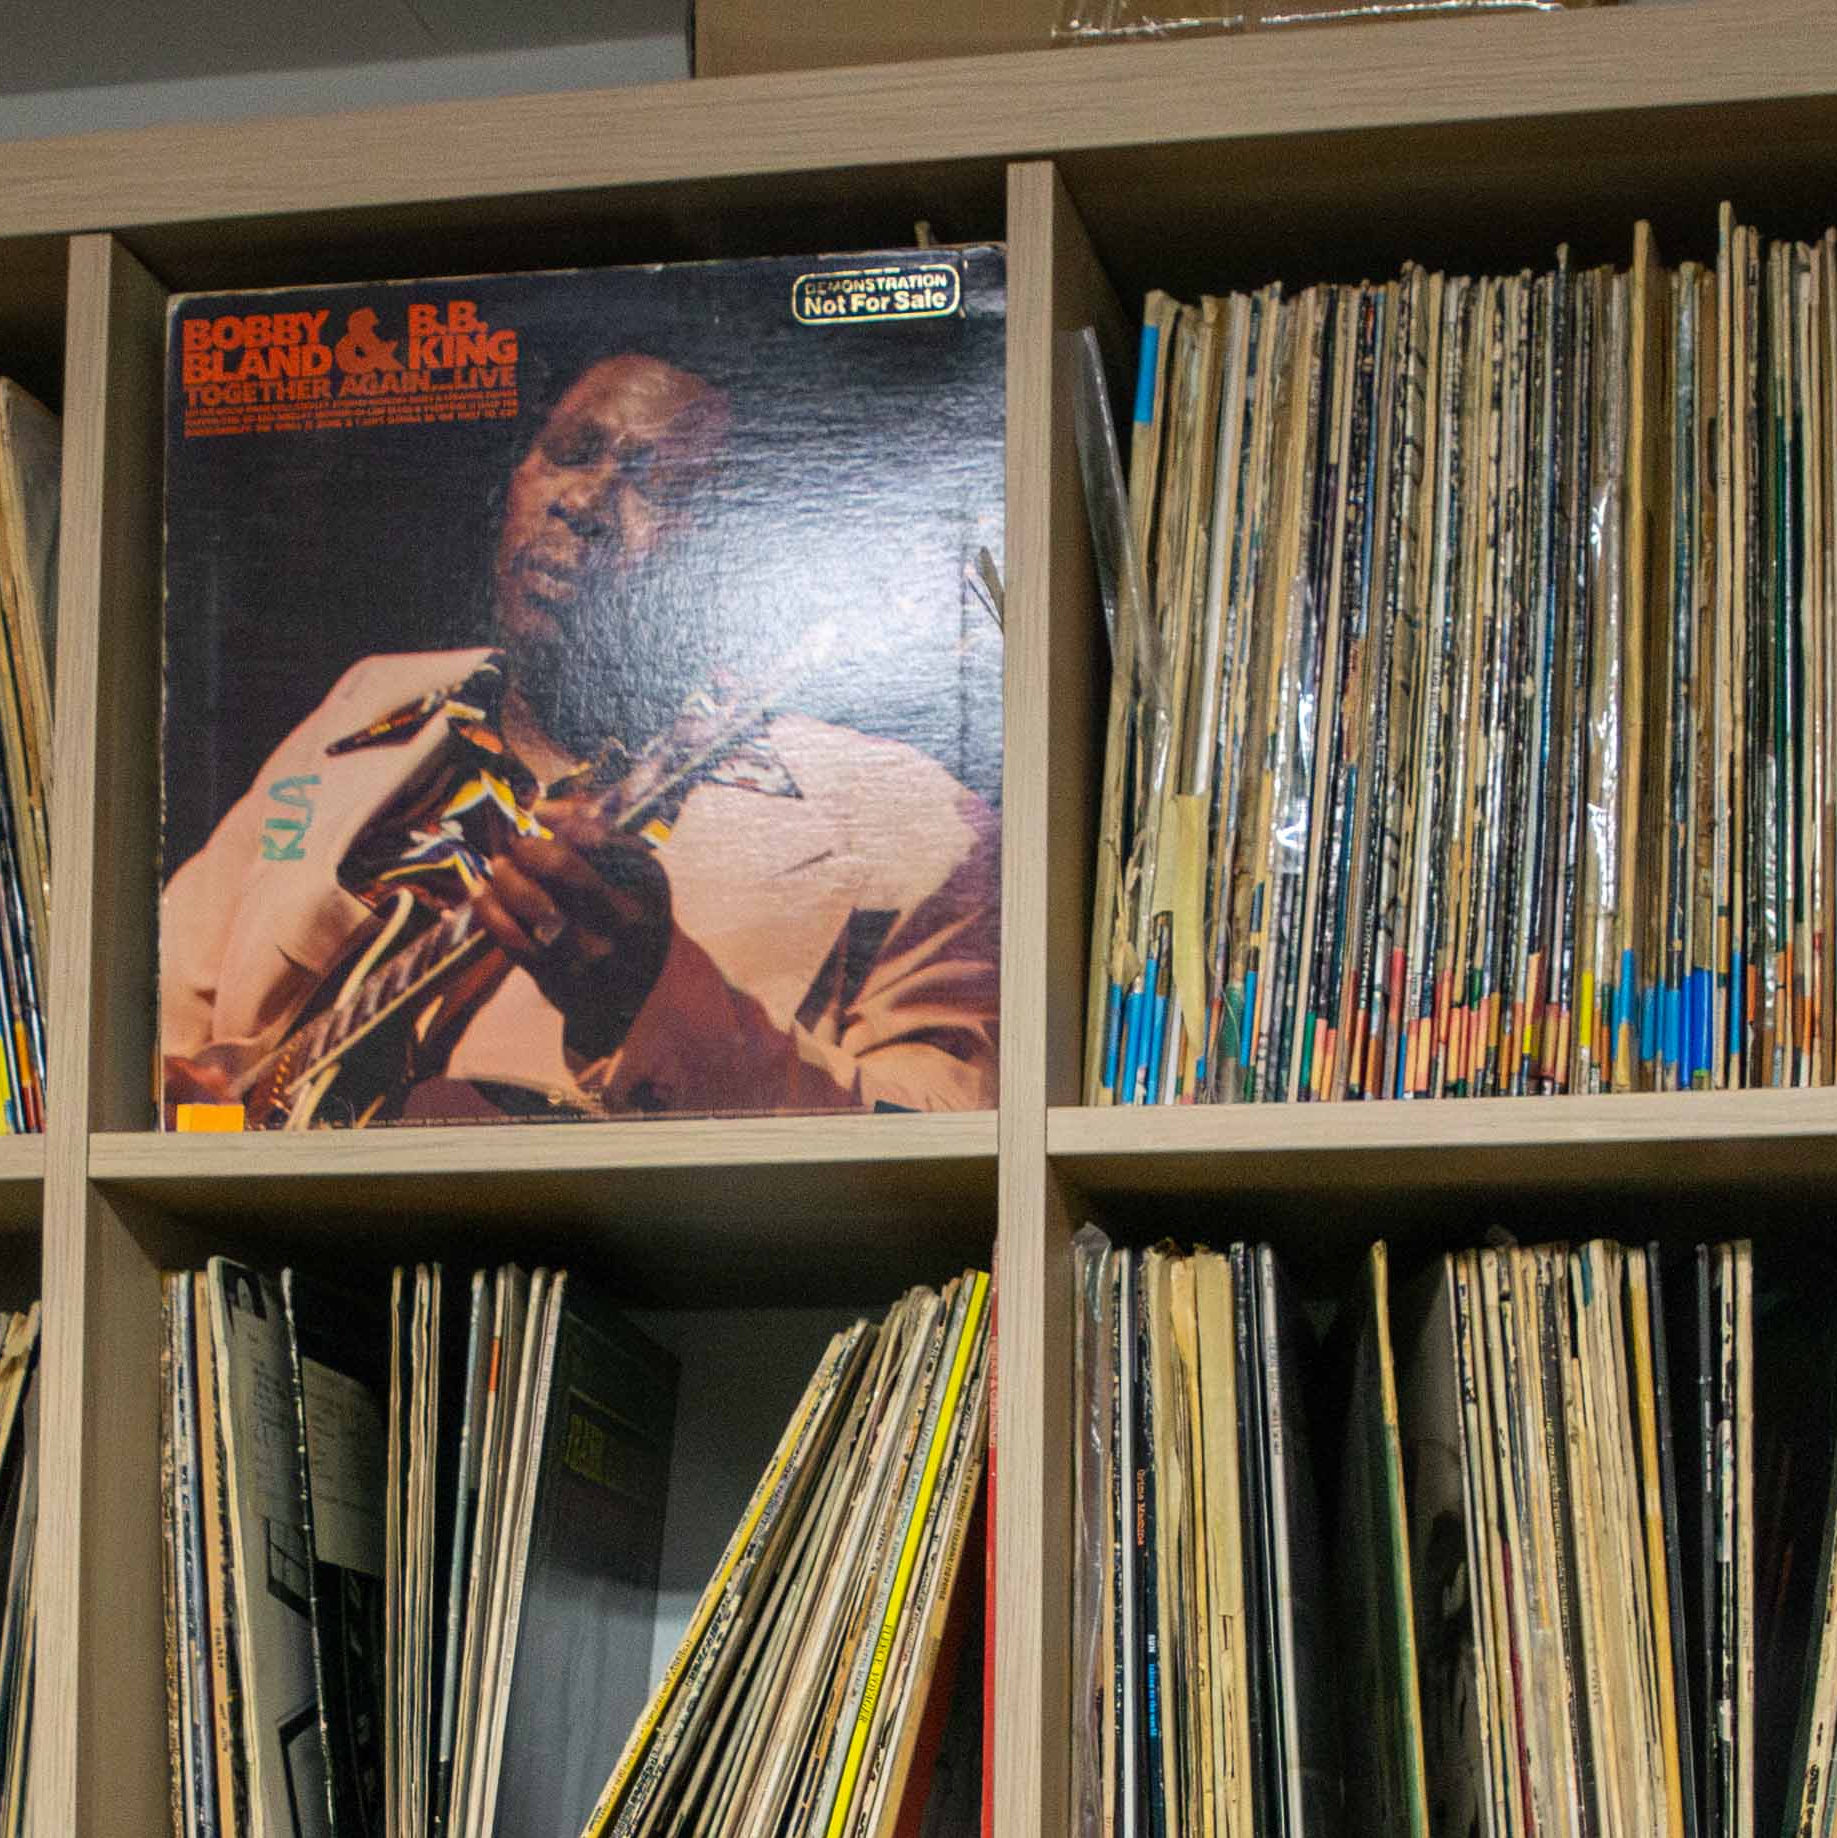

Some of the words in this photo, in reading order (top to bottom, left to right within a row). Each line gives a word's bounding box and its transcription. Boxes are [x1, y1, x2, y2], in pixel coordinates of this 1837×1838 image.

[804, 272, 948, 296] DEMONSTRATION
[804, 294, 846, 316] Not
[850, 291, 891, 313] For
[893, 287, 947, 311] Sale
[183, 309, 330, 351] BOBBY
[409, 299, 489, 337] B.B.
[334, 306, 403, 376] &
[409, 330, 519, 370] KING
[183, 344, 333, 384] BLAND
[184, 377, 333, 408] TOGETHER
